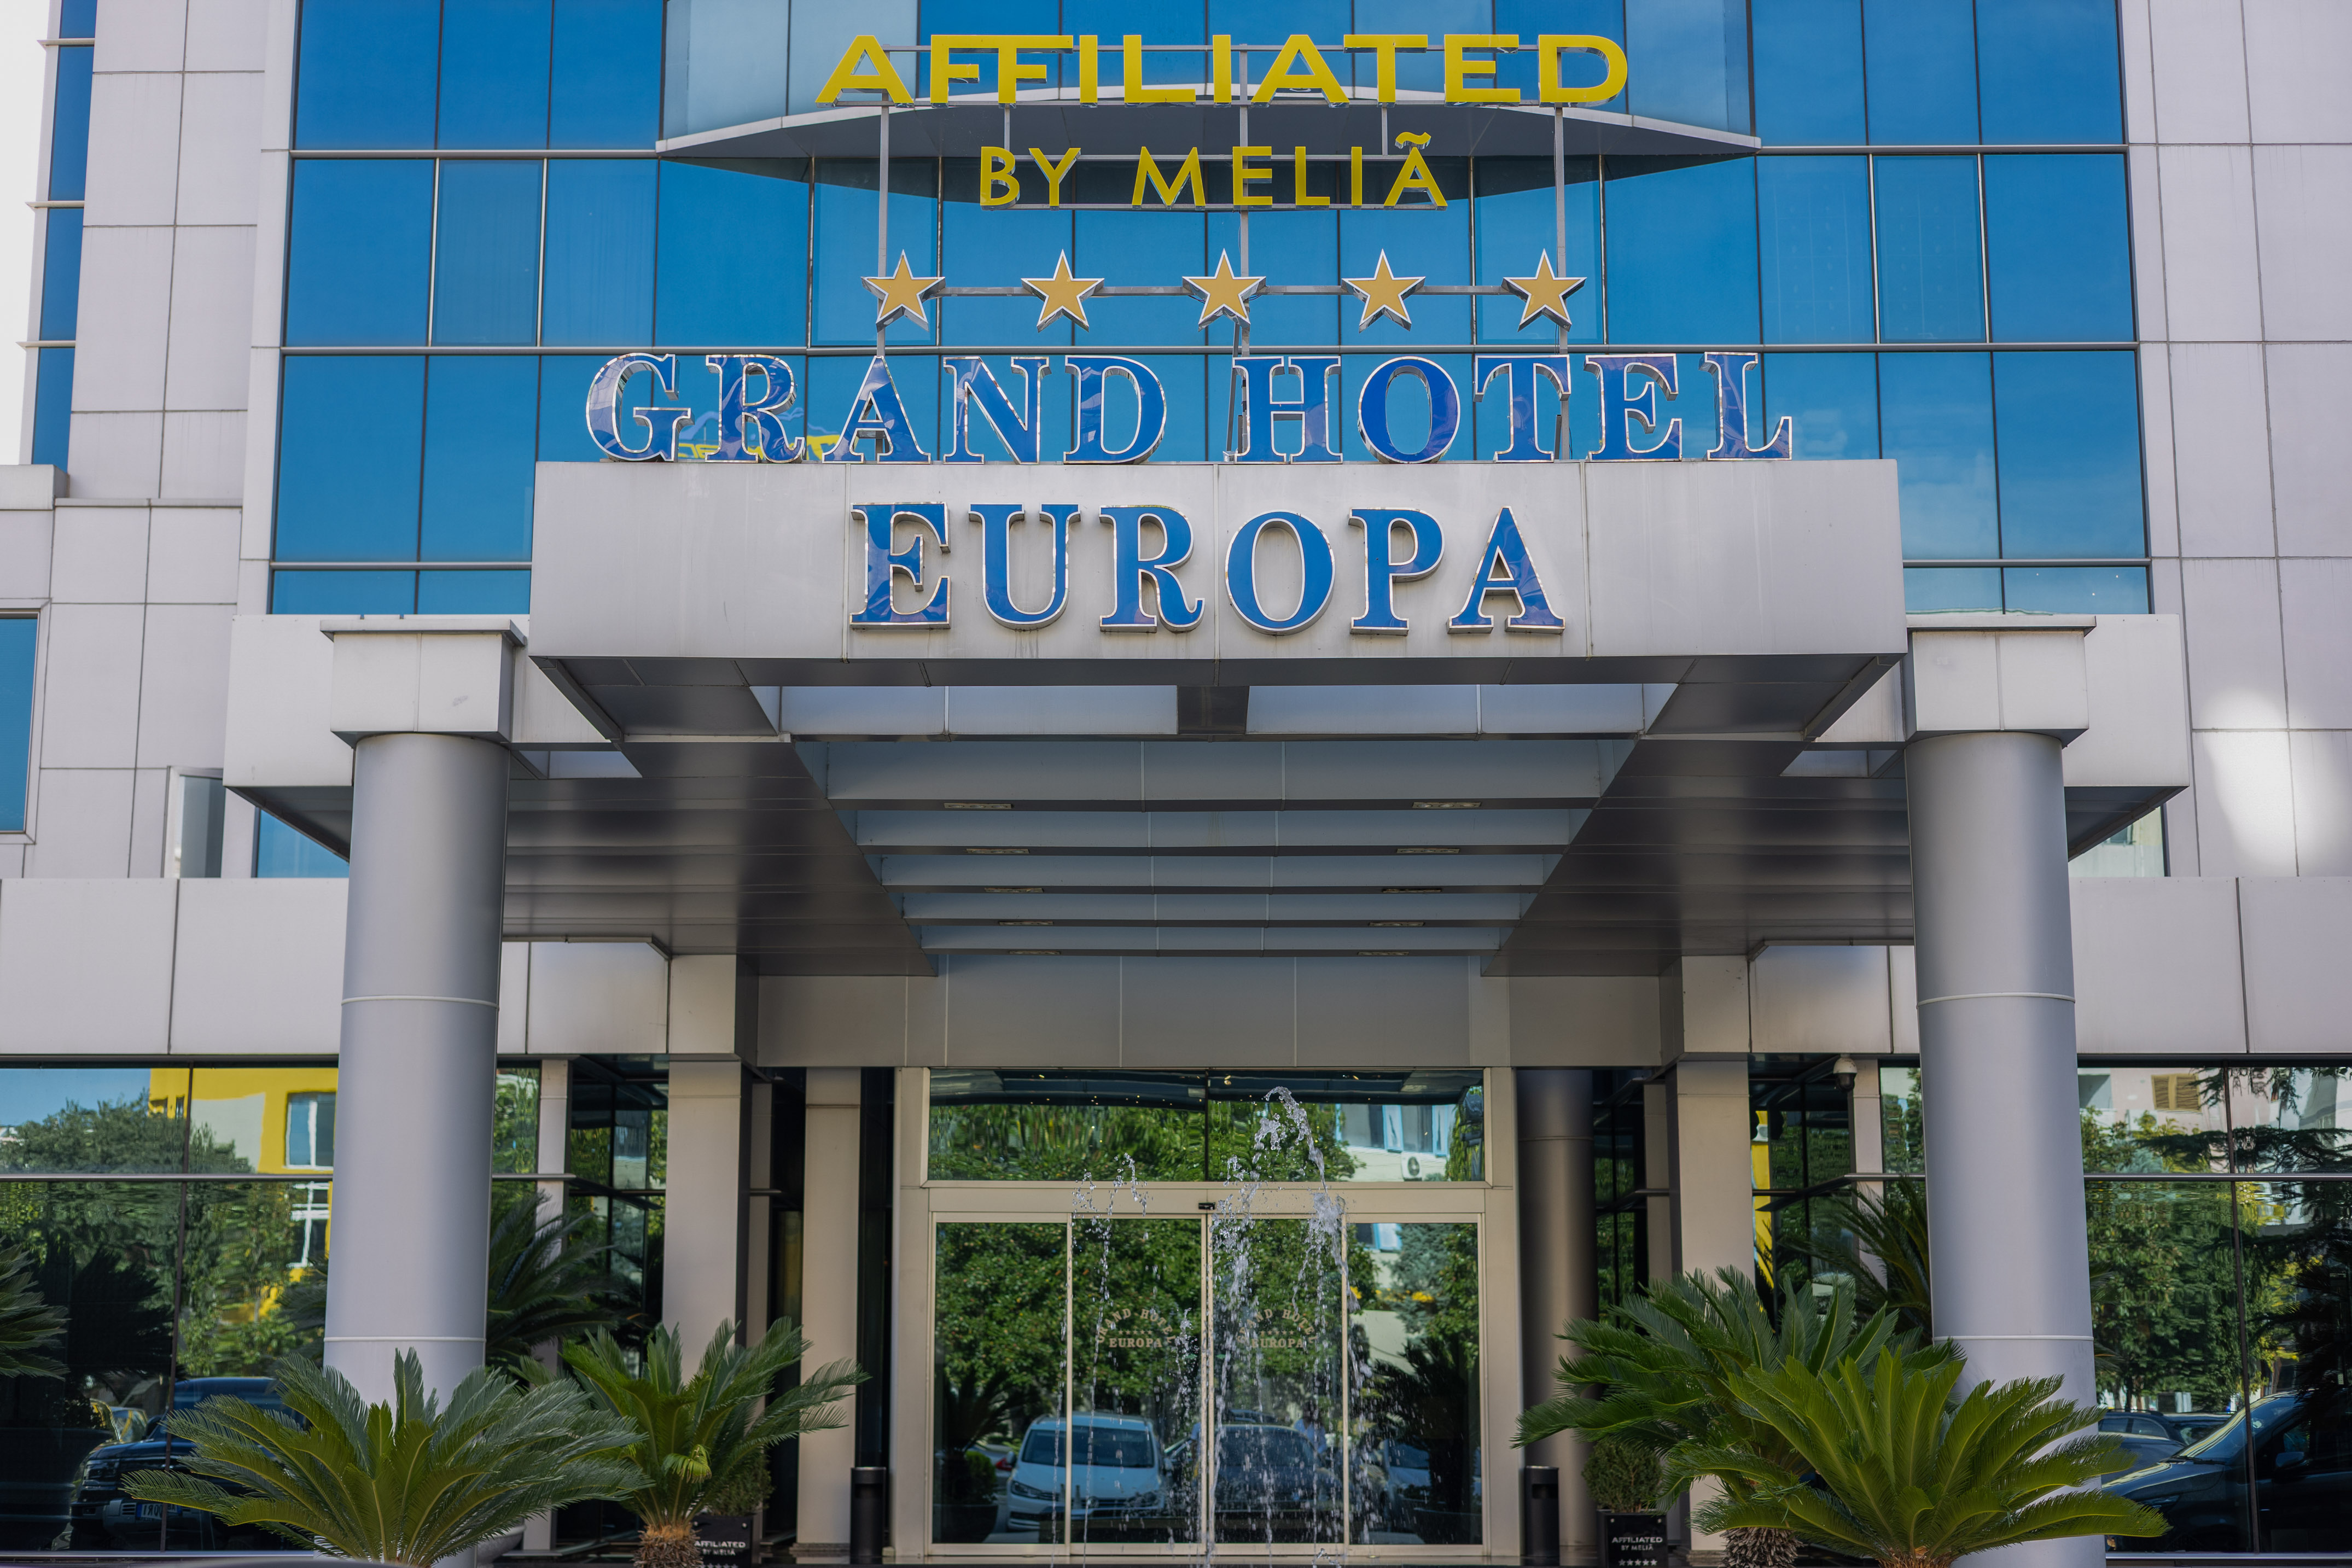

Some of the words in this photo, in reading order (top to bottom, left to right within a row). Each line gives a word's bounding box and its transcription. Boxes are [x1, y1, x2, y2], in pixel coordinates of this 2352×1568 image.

[815, 34, 1628, 108] AFFILIATED
[980, 146, 1081, 210] BY
[1132, 131, 1448, 211] MELIÃ
[586, 352, 1167, 464] GRAND
[1231, 351, 1792, 464] HOTEL
[849, 502, 1565, 636] EUROPA
[1095, 1308, 1132, 1343] GRAND
[1140, 1309, 1176, 1343] HOTEL
[1109, 1338, 1163, 1348] EUROPA
[1252, 1338, 1304, 1348] EUROPA
[1282, 1309, 1318, 1344] HOTEL
